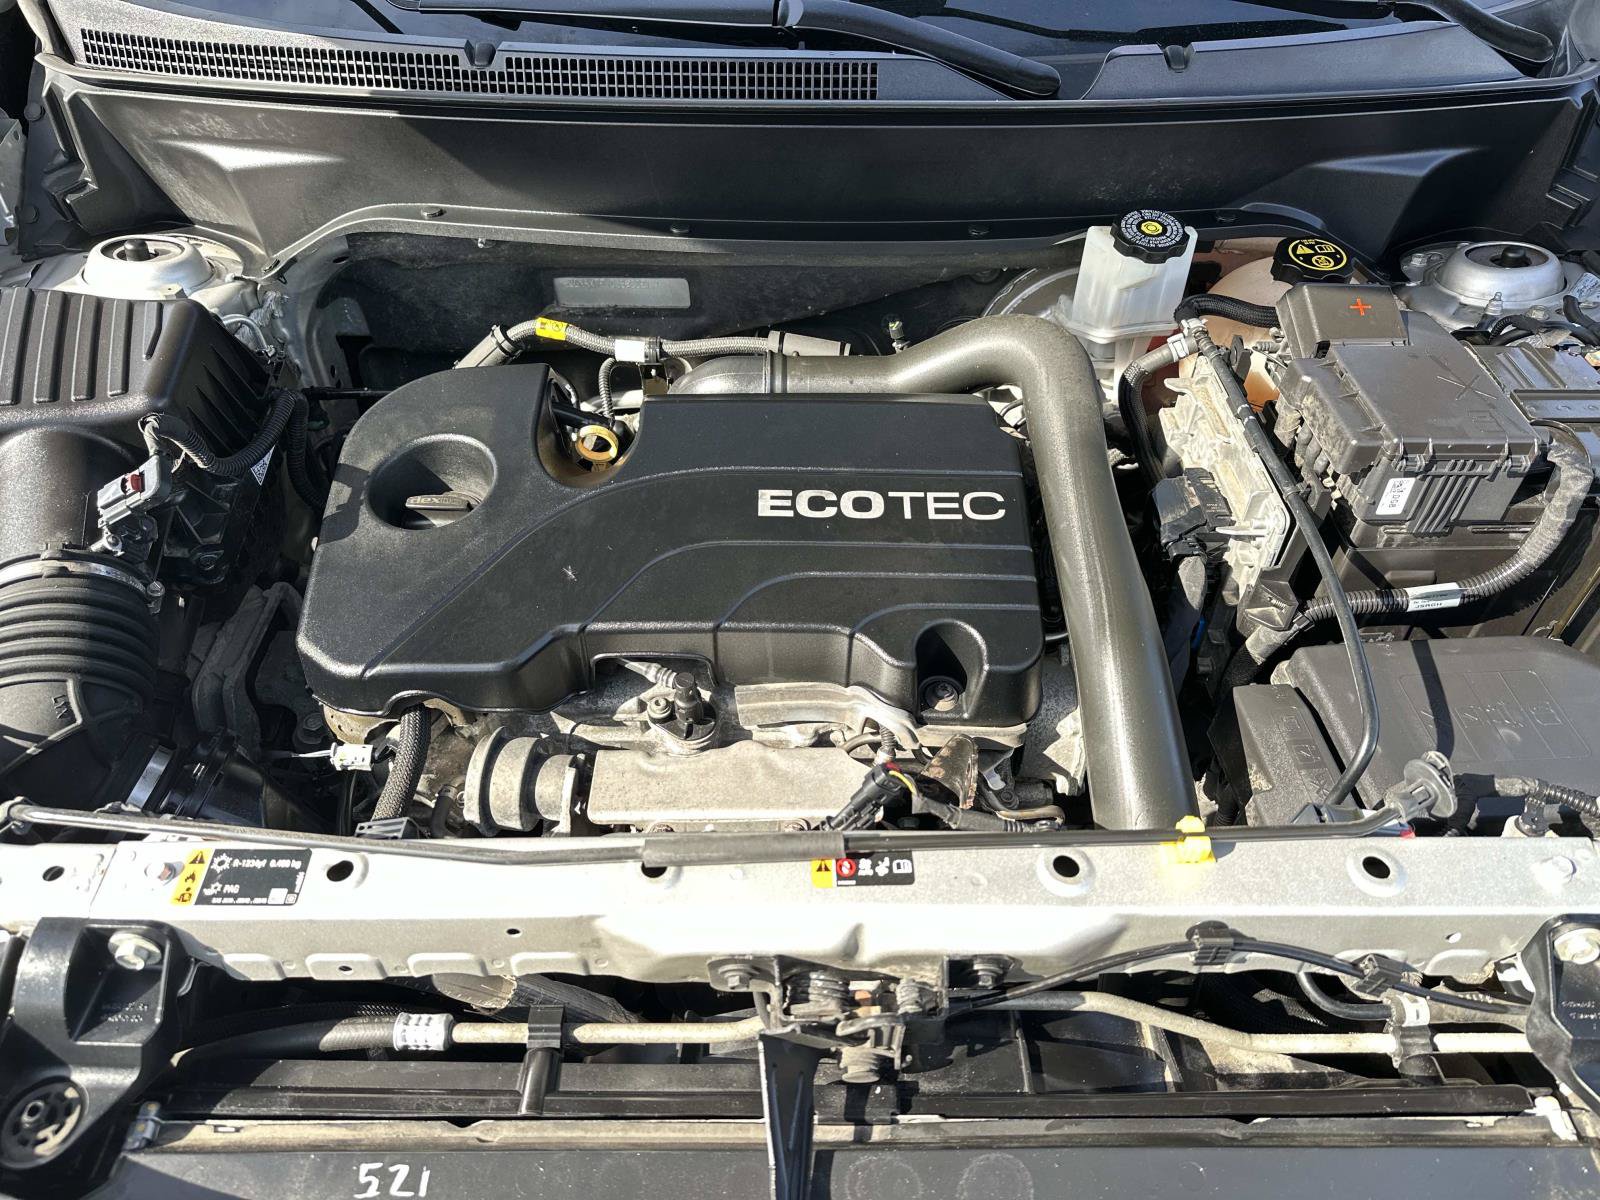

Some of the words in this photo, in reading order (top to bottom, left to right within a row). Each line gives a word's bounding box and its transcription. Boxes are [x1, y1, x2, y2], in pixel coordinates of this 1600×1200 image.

[757, 489, 1006, 521] ECOTEC
[222, 884, 240, 894] PAG
[353, 1162, 431, 1199] 521
